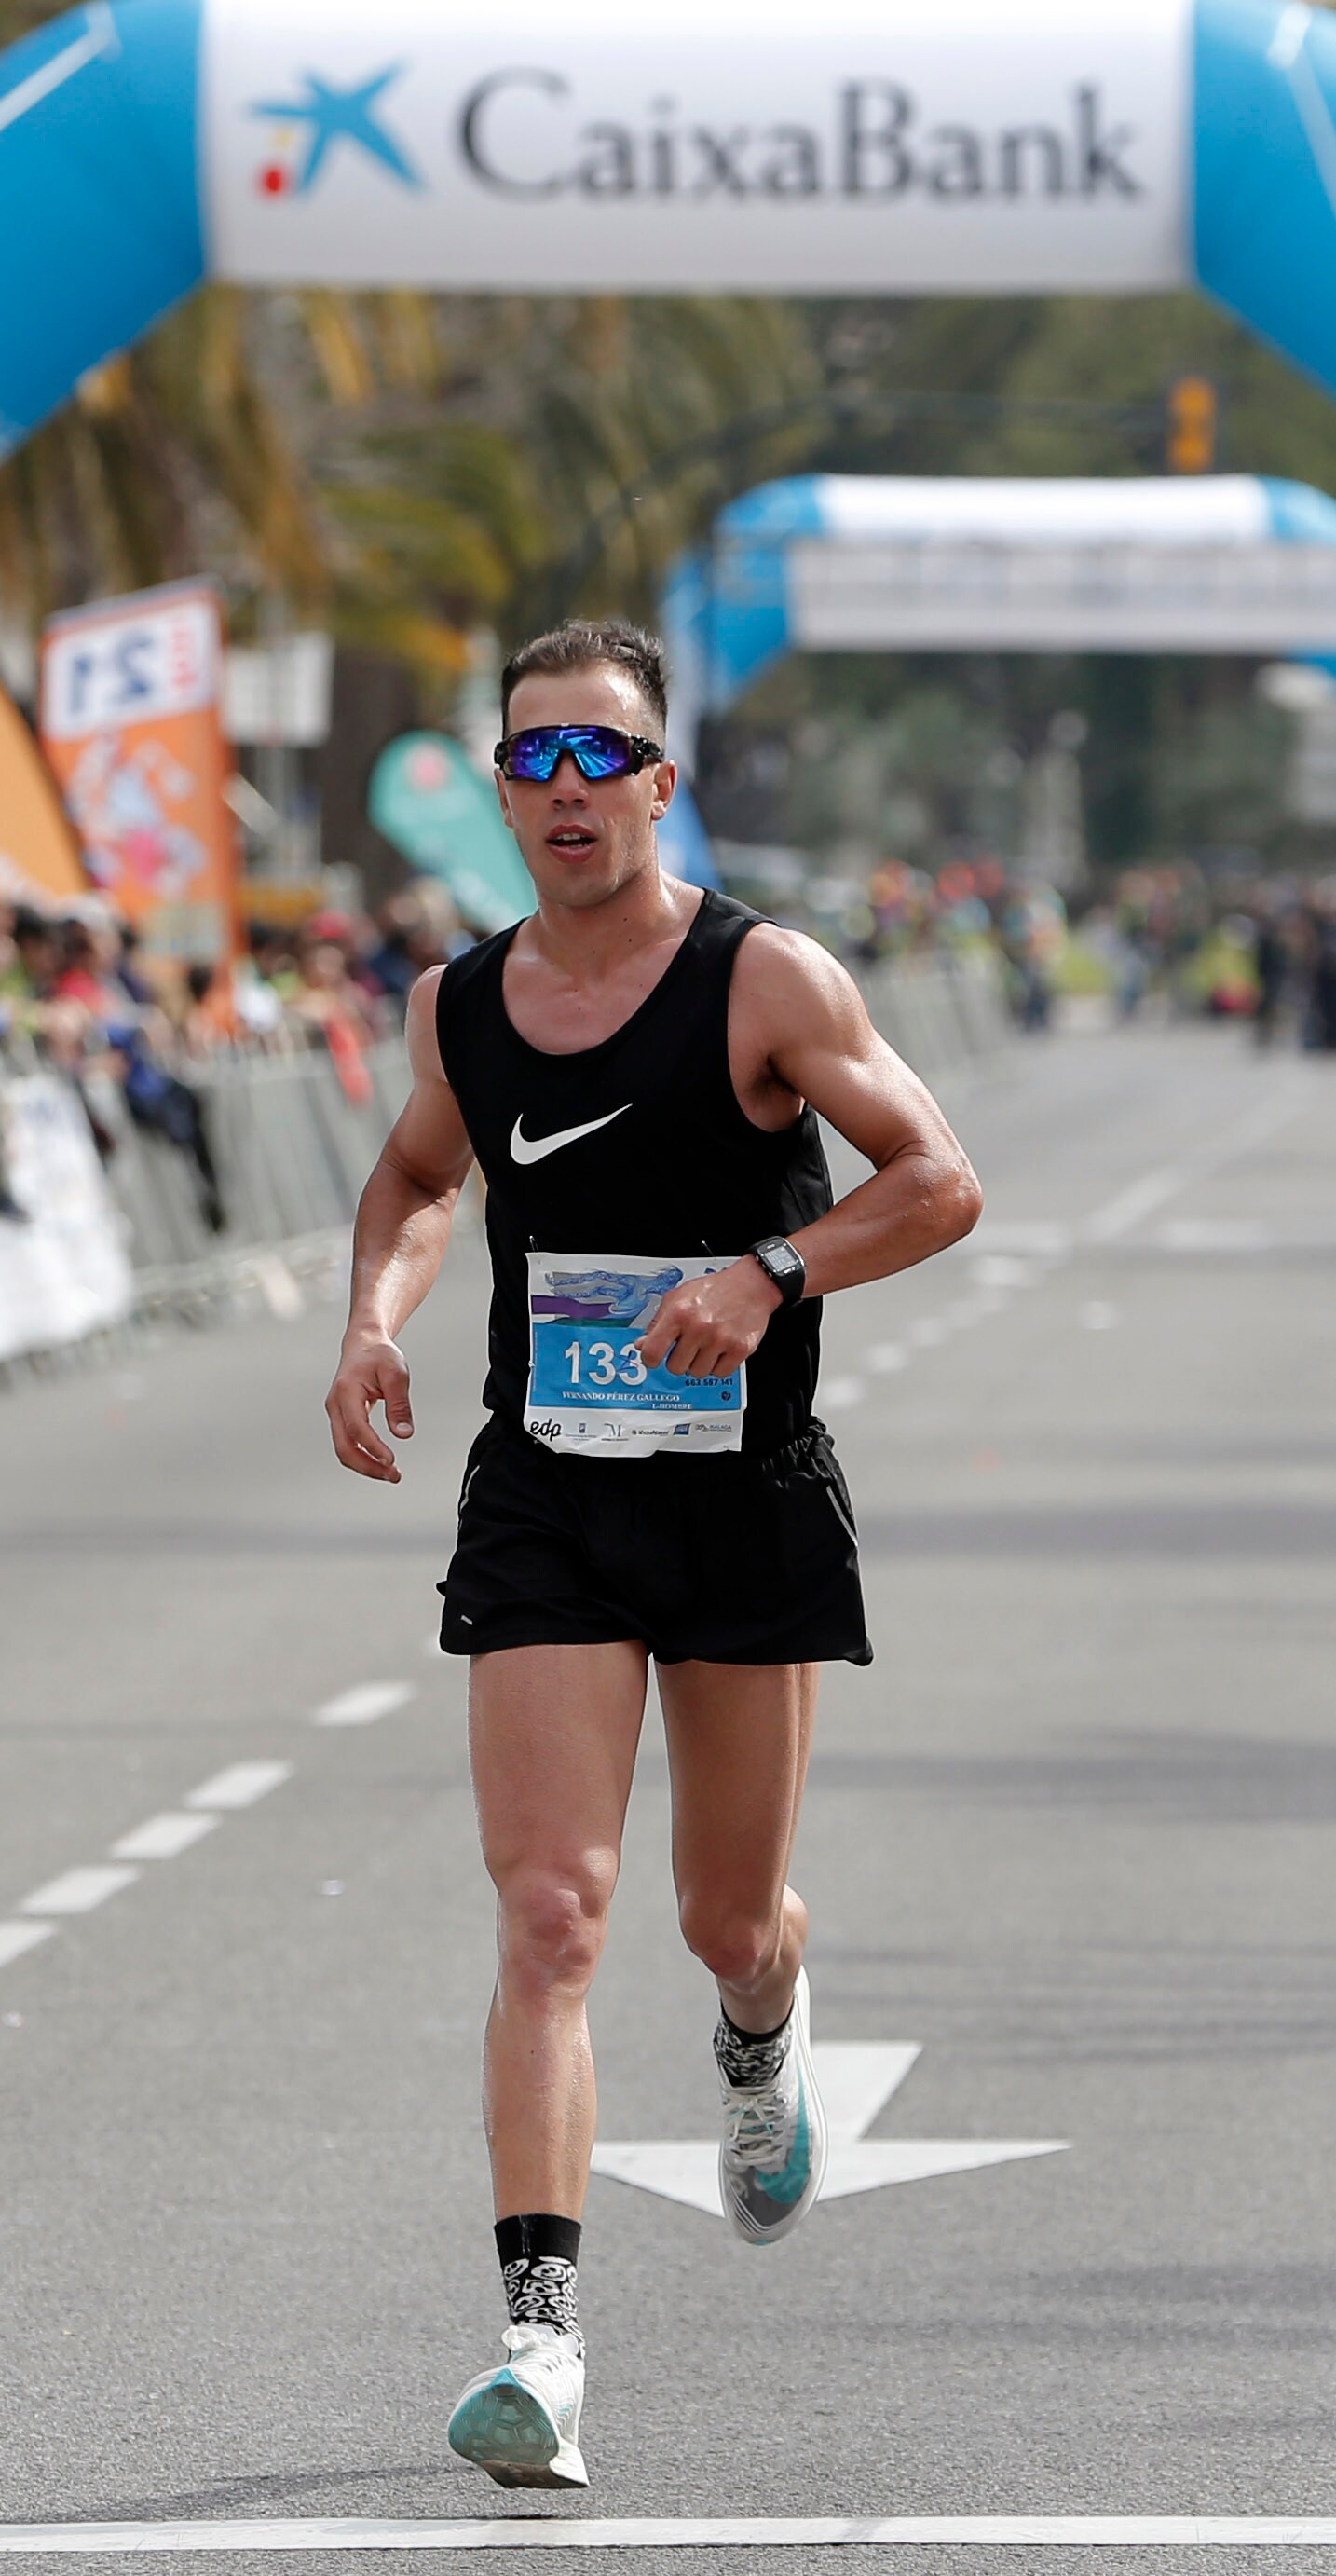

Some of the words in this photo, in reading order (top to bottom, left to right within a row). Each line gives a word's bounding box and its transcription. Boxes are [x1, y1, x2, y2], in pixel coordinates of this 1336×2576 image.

[457, 68, 1143, 200] CaixaBank
[565, 1341, 648, 1386] 133
[562, 1391, 606, 1401] FERNANDO
[607, 1391, 635, 1401] PÉREZ
[637, 1393, 680, 1402] GALLEGO
[529, 1418, 562, 1442] edp
